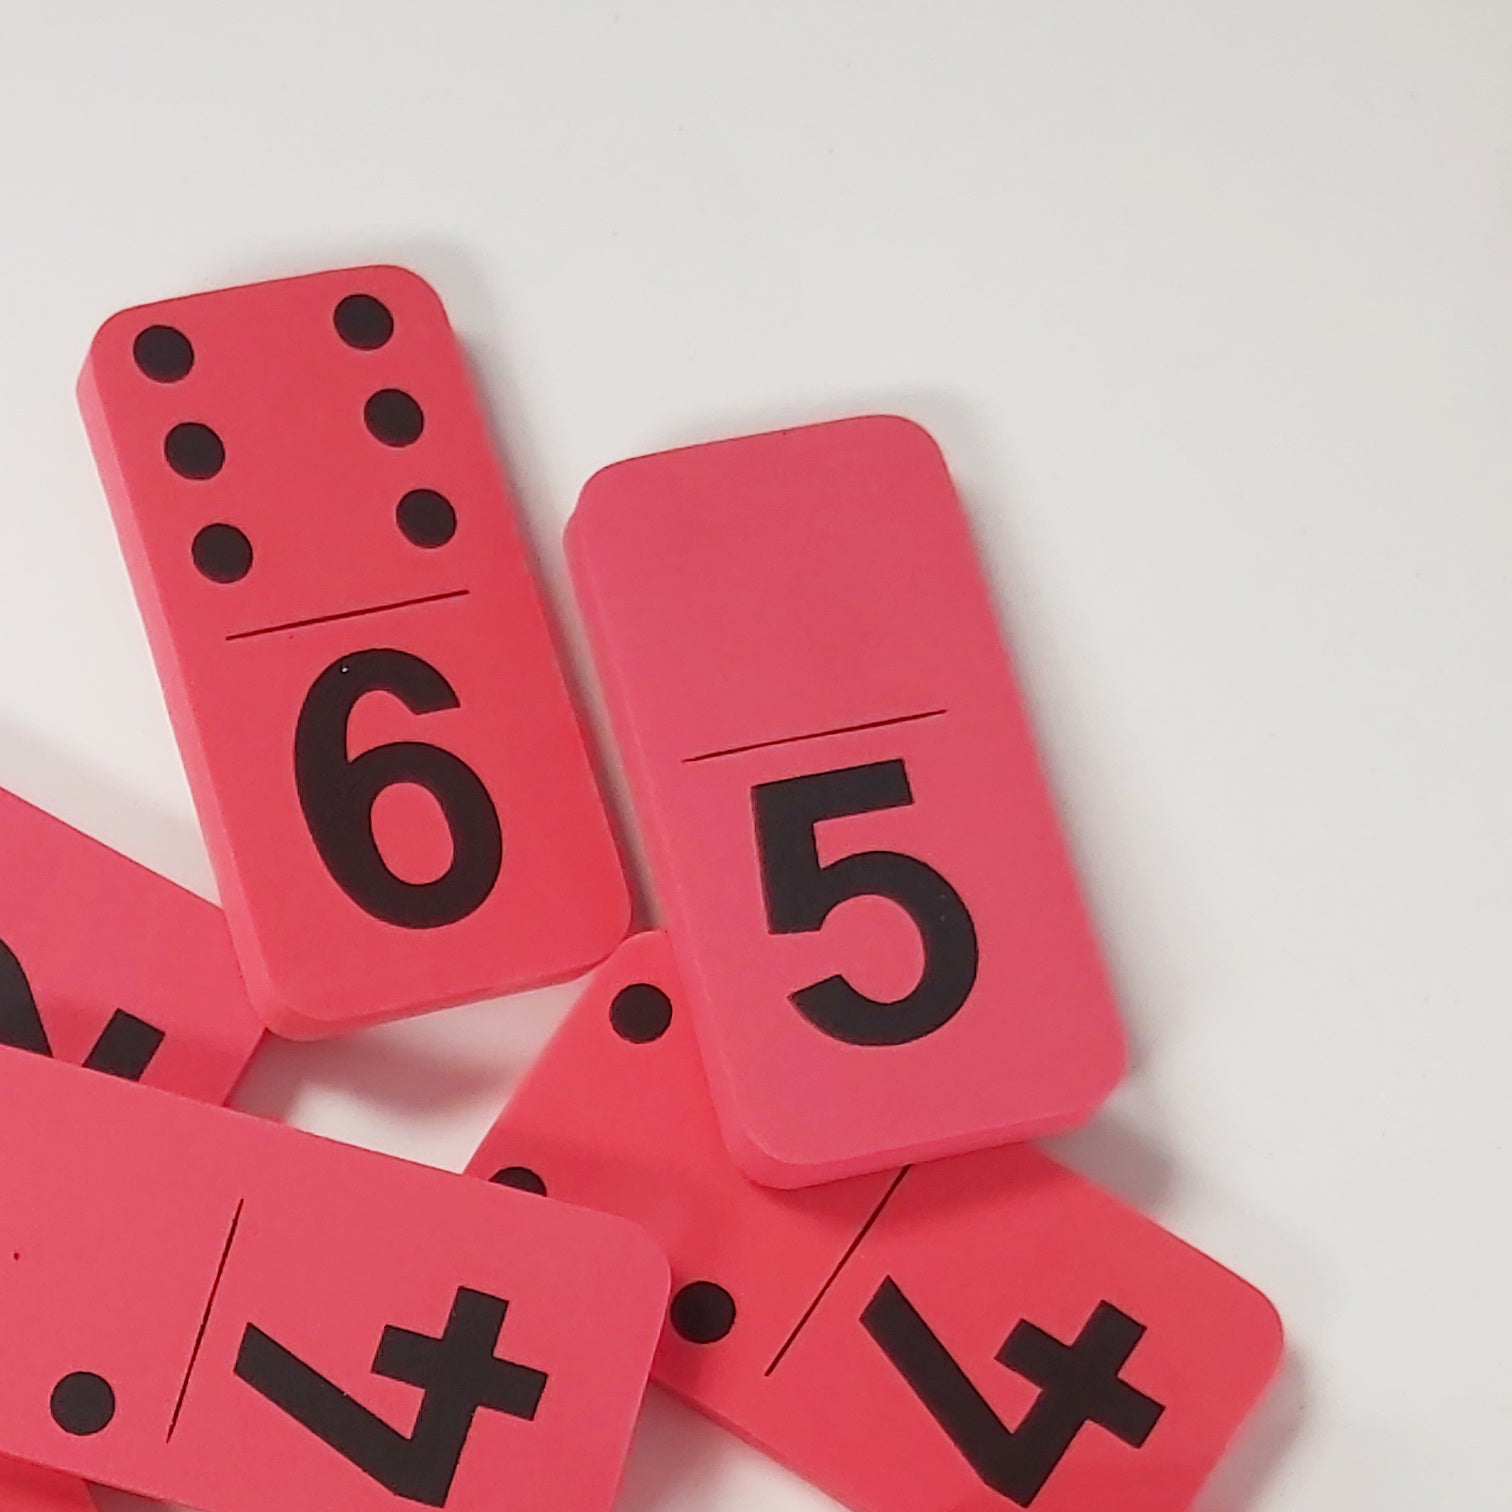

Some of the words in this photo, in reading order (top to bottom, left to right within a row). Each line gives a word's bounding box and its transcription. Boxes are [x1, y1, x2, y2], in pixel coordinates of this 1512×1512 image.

[295, 649, 502, 928] 6
[754, 759, 978, 1046] 5
[235, 1287, 548, 1507] 4
[863, 1276, 1165, 1507] 4
